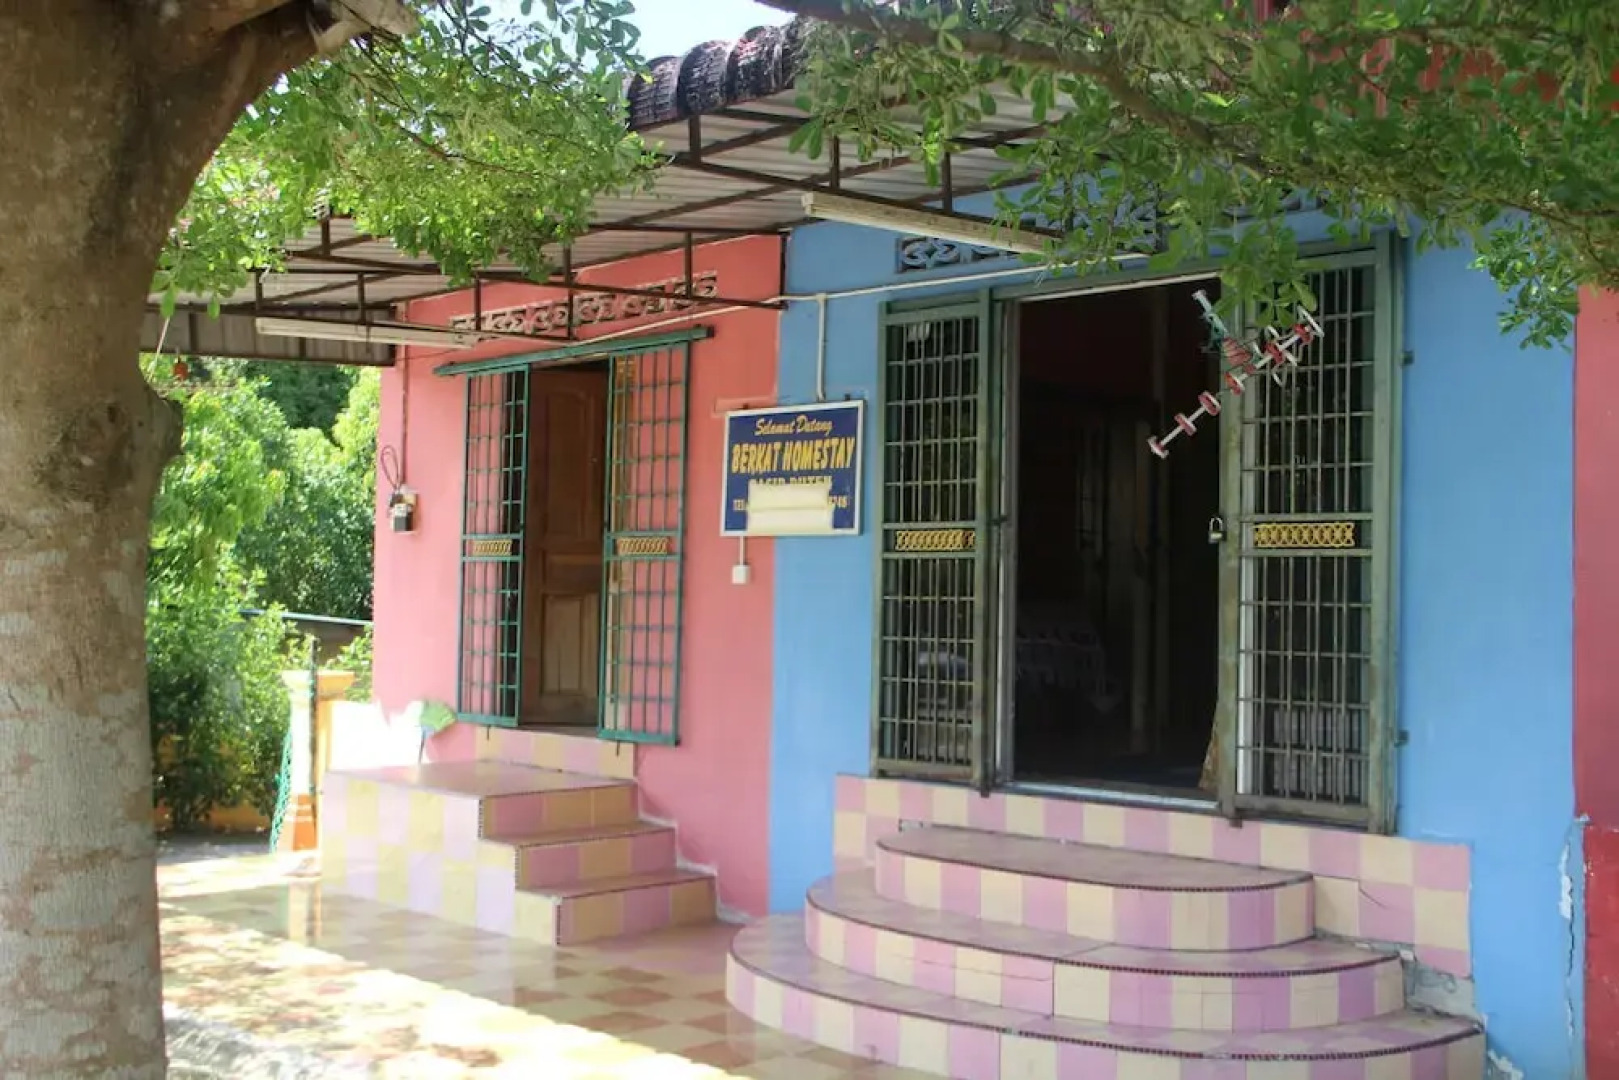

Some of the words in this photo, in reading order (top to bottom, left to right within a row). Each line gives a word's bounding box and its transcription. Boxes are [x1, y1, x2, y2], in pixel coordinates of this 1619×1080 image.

[755, 419, 795, 435] Selamat
[796, 414, 832, 436] Datang
[732, 442, 782, 474] BERKAT
[782, 438, 855, 471] HOMESTAY
